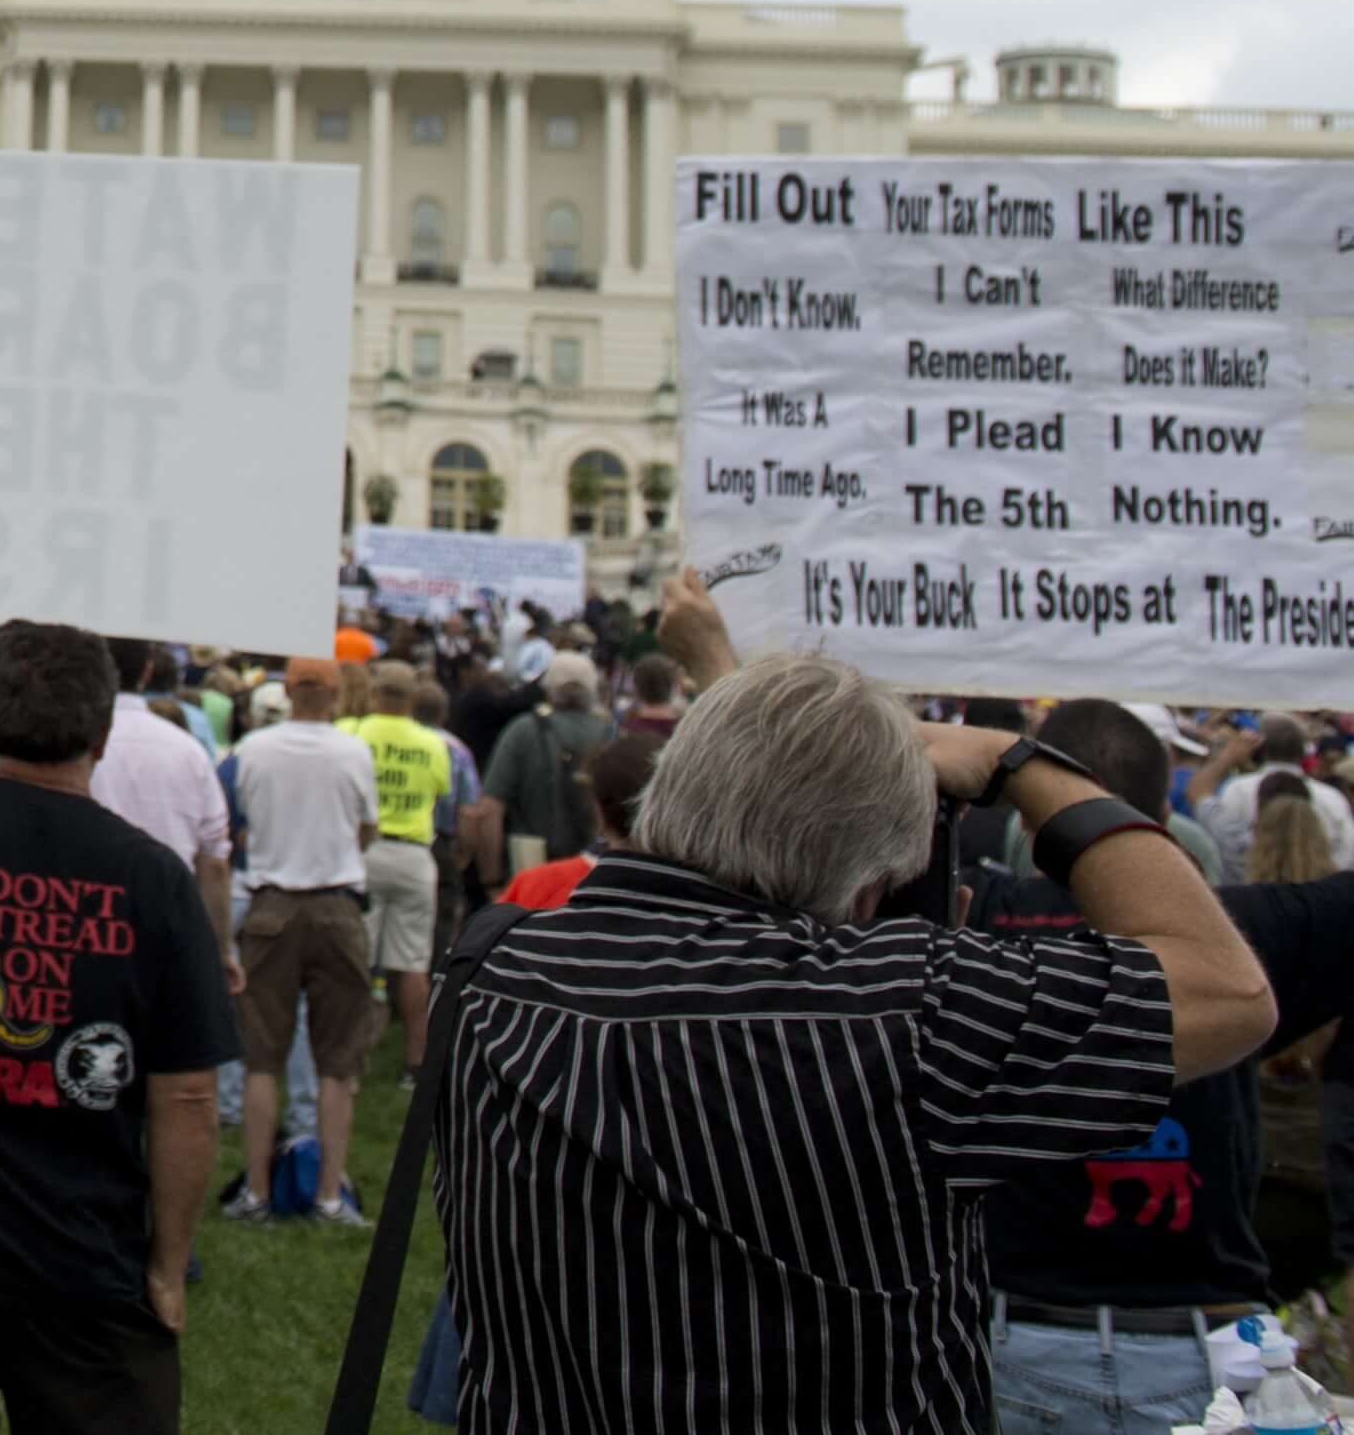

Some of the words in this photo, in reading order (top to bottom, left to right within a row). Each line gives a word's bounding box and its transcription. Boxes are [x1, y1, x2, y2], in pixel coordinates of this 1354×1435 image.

[694, 171, 760, 224] Fill
[776, 173, 855, 227] Out
[881, 181, 932, 236] Your
[936, 182, 979, 238] Tax
[984, 185, 1055, 241] Forms
[1077, 190, 1153, 245] Like
[1165, 191, 1245, 248] This
[700, 275, 709, 326] I
[717, 276, 780, 330] Don't
[787, 278, 861, 331] Know.
[935, 265, 945, 304] I
[964, 264, 1042, 306] Can't
[1112, 267, 1166, 310] What
[1170, 270, 1280, 313] Difference
[907, 340, 1073, 384] Remember.
[1123, 344, 1176, 388] Does
[1179, 347, 1197, 388] it
[1200, 347, 1269, 390] Make?
[762, 392, 807, 428] Was
[812, 390, 829, 427] A
[905, 408, 916, 447] I
[947, 409, 1065, 453] Plead
[1112, 414, 1122, 451] I
[1150, 415, 1264, 456] Know
[705, 459, 757, 506] Long
[761, 459, 816, 499] Time
[820, 462, 867, 509] Ago.
[904, 484, 986, 527] The
[1001, 488, 1070, 531] 5th
[1112, 485, 1282, 538] Nothing.
[804, 560, 844, 626] It's
[848, 561, 907, 628] Your
[912, 562, 977, 630] Buck
[999, 568, 1026, 622] It
[1036, 568, 1133, 637] Stops
[1142, 574, 1177, 625] at
[1203, 574, 1253, 644] The
[3, 947, 76, 986] ON
[4, 984, 73, 1025] ME
